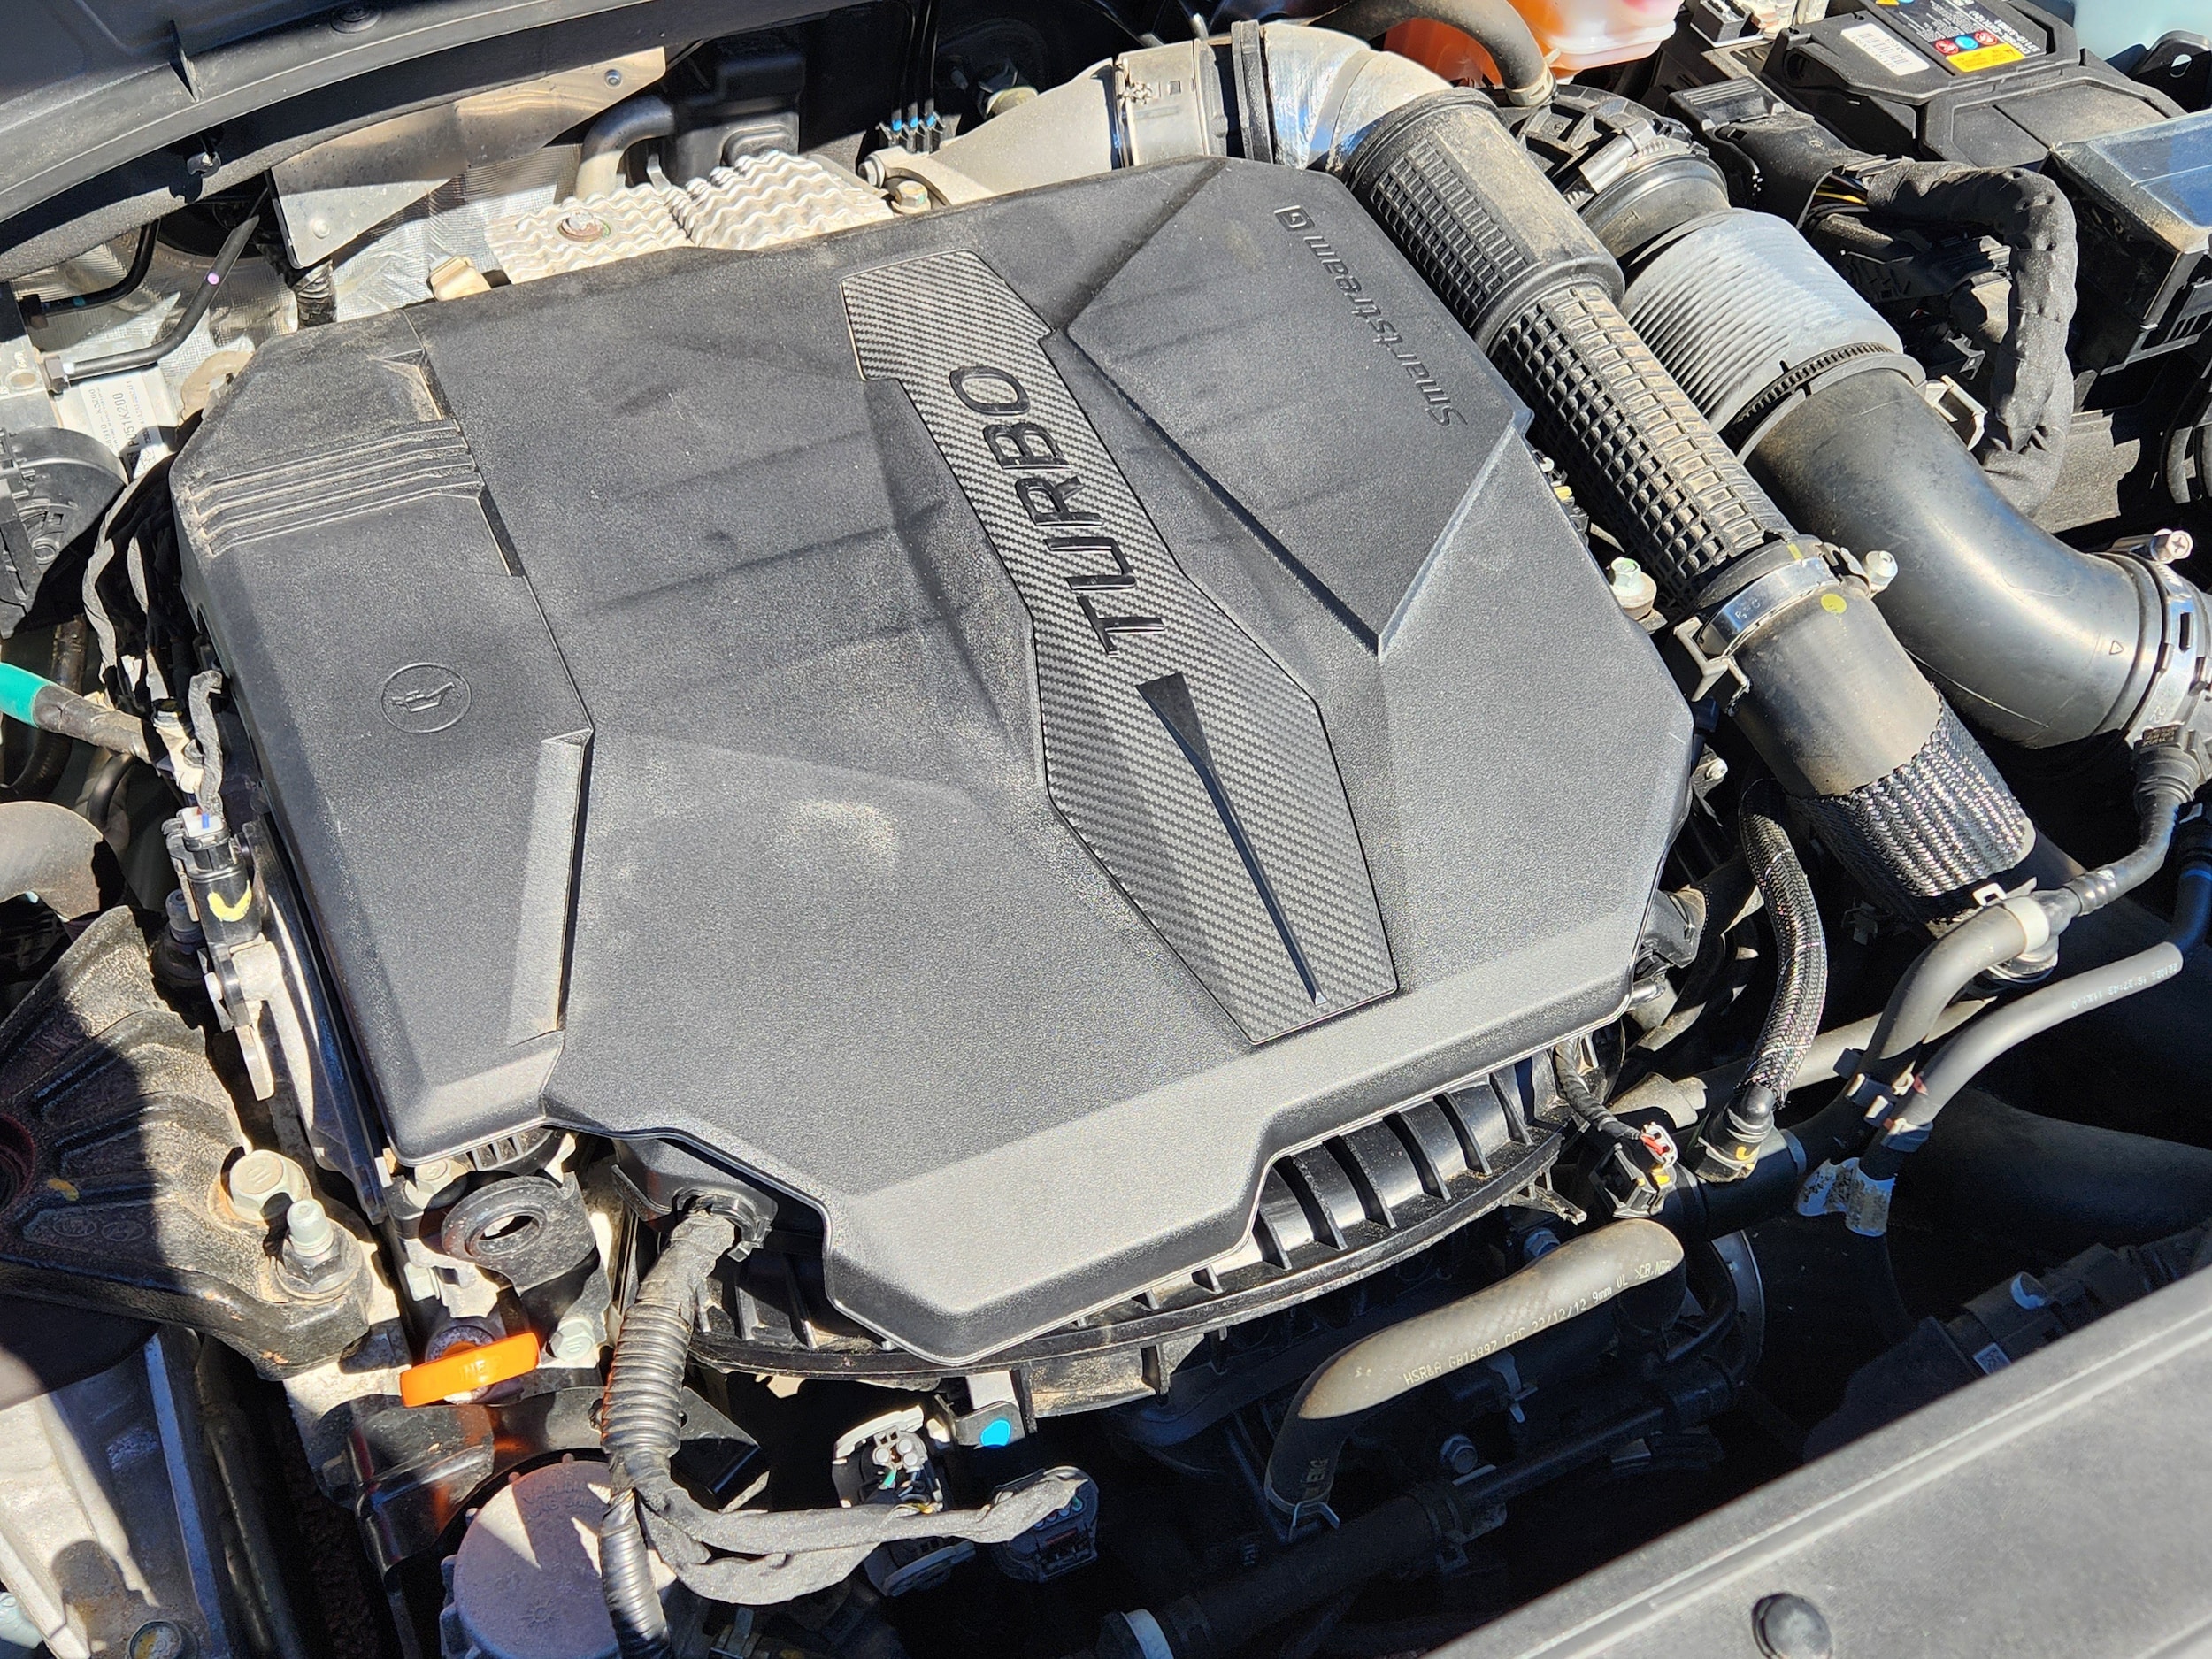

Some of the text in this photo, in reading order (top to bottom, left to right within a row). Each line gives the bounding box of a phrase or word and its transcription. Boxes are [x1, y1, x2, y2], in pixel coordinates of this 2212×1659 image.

[1303, 235, 1468, 426] Smartstream
[949, 365, 1165, 656] TURBO
[1402, 1362, 1442, 1386] HSR&A
[1592, 1286, 1612, 1304] 9mm
